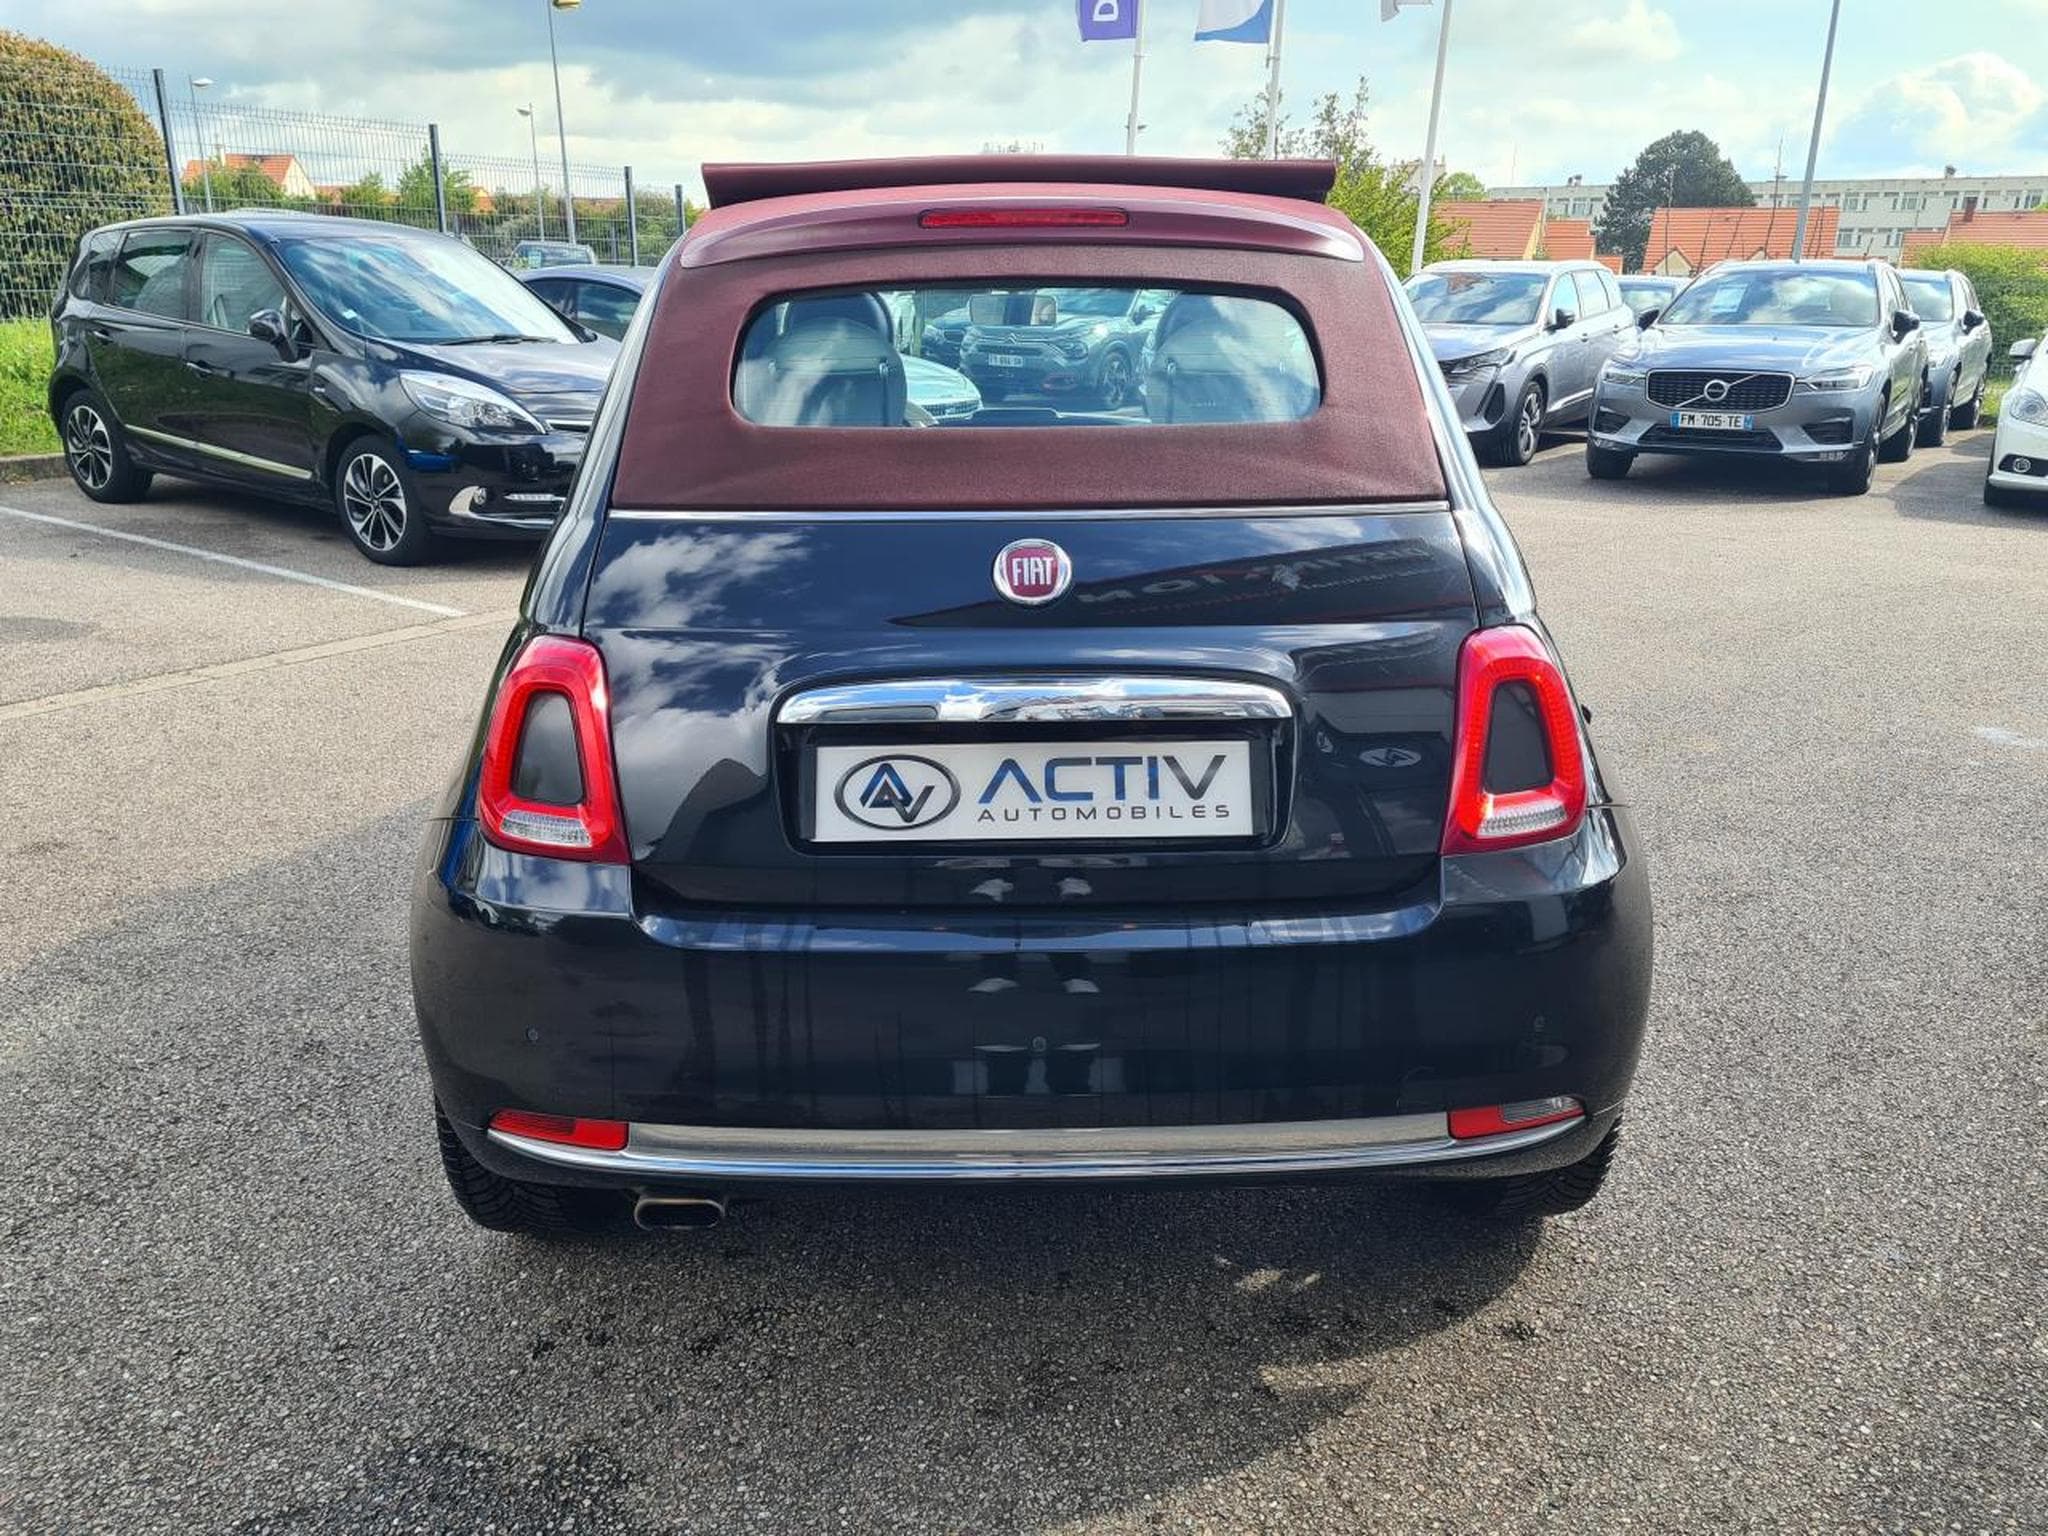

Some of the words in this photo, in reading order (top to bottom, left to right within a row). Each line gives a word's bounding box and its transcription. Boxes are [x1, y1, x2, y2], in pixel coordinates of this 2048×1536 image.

[1012, 557, 1054, 586] FIAT
[977, 755, 1227, 804] ACTIV
[978, 804, 1230, 822] AUTOMOBILES
